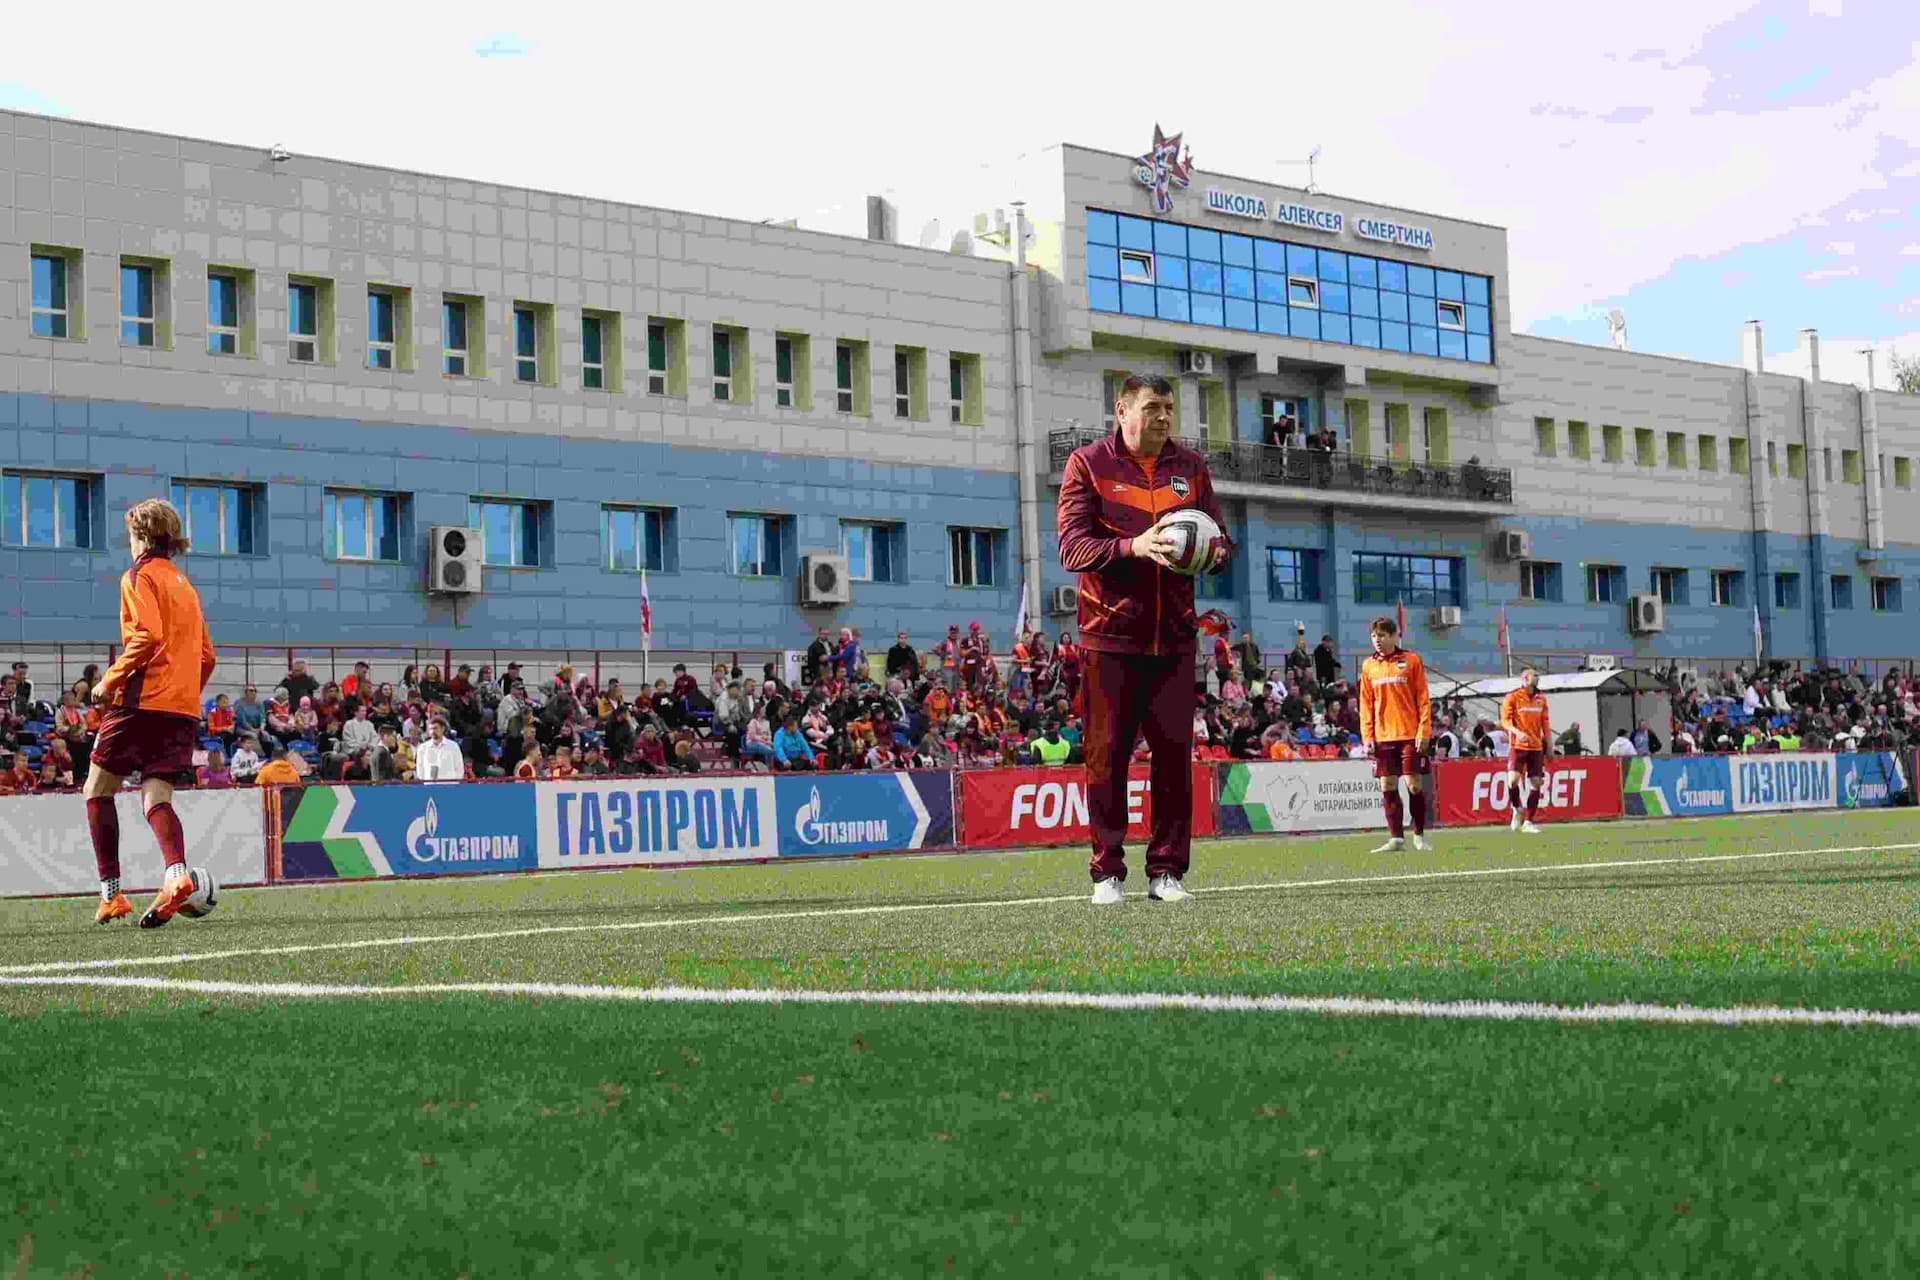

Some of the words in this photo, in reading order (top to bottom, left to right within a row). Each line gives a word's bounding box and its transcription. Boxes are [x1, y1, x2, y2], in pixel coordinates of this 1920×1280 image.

[1208, 190, 1267, 216] ШКОЛА
[1278, 204, 1342, 230] АЛЕКСЕЯ
[1358, 219, 1433, 248] СМЕРТИНА
[1318, 780, 1363, 795] АЛТАЙСКАЯ
[1739, 760, 1830, 805] ГАЗПРОМ
[556, 787, 761, 856] ГАЗПРОМ
[1009, 780, 1152, 829] FONE
[1313, 798, 1373, 812] НОТАРИАЛЬНАЯ
[440, 835, 519, 863] ГАЗПРОМ
[822, 819, 888, 845] ГАЗПРОМ
